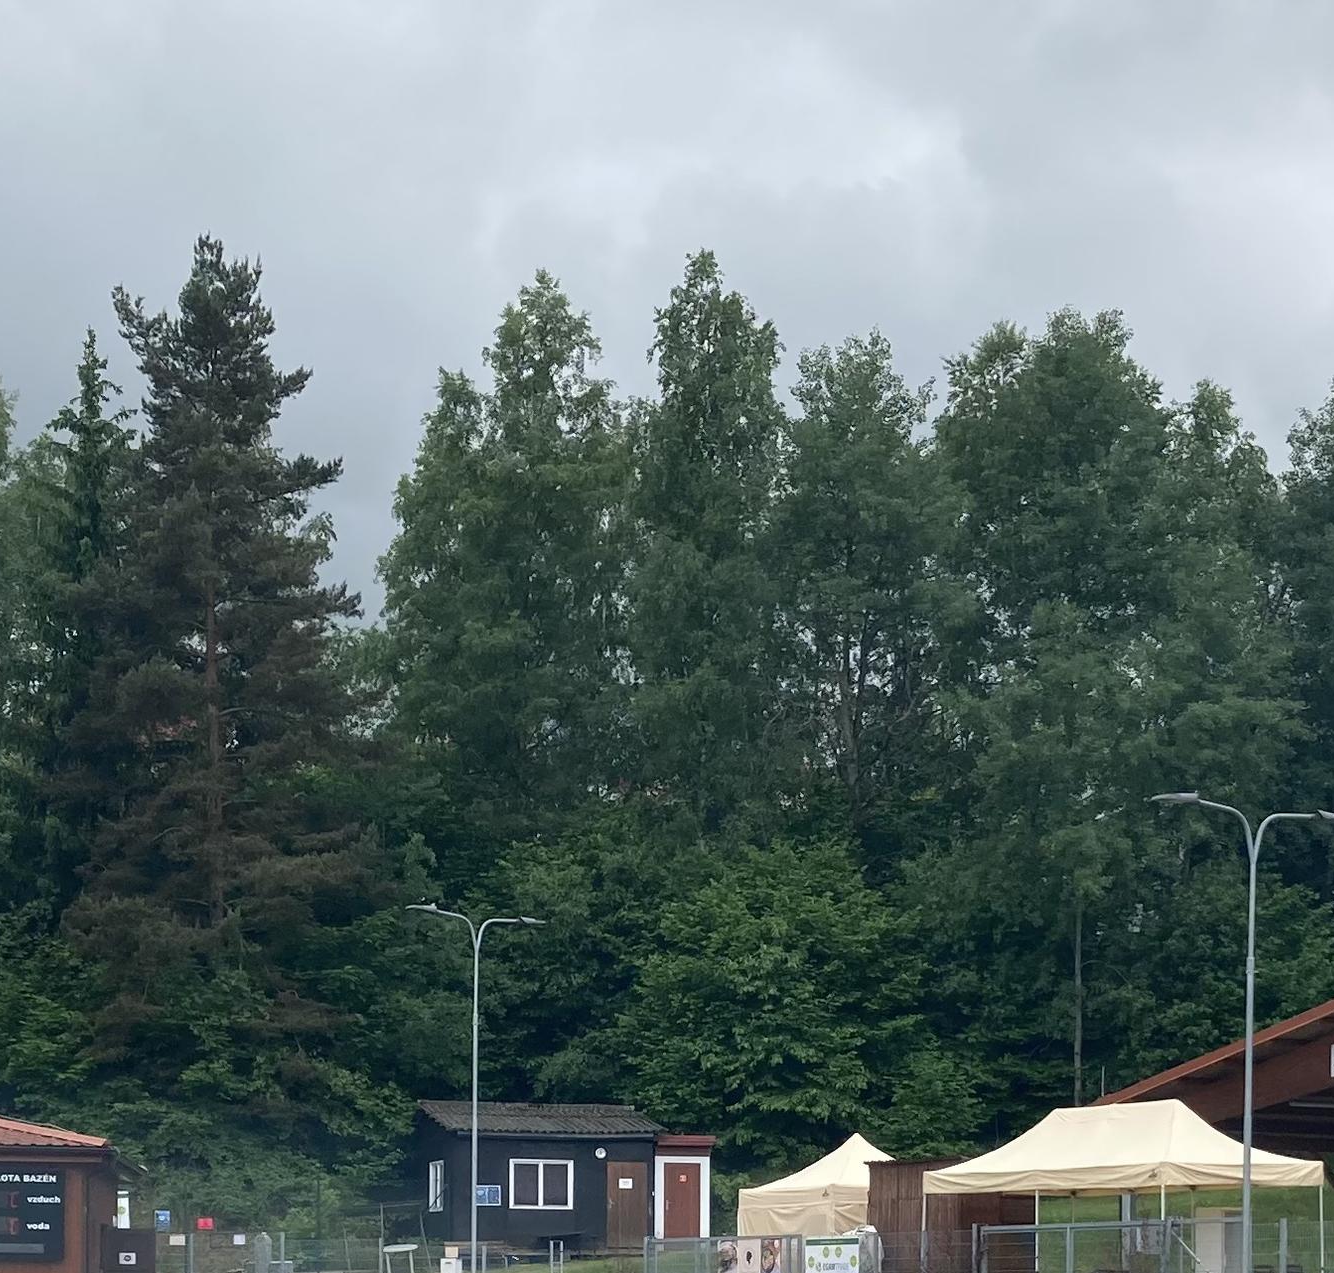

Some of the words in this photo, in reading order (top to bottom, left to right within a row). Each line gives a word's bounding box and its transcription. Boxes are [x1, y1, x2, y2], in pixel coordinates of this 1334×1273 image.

[23, 1173, 57, 1183] BAZÉN
[27, 1195, 61, 1204] vzduch
[26, 1222, 50, 1230] voda
